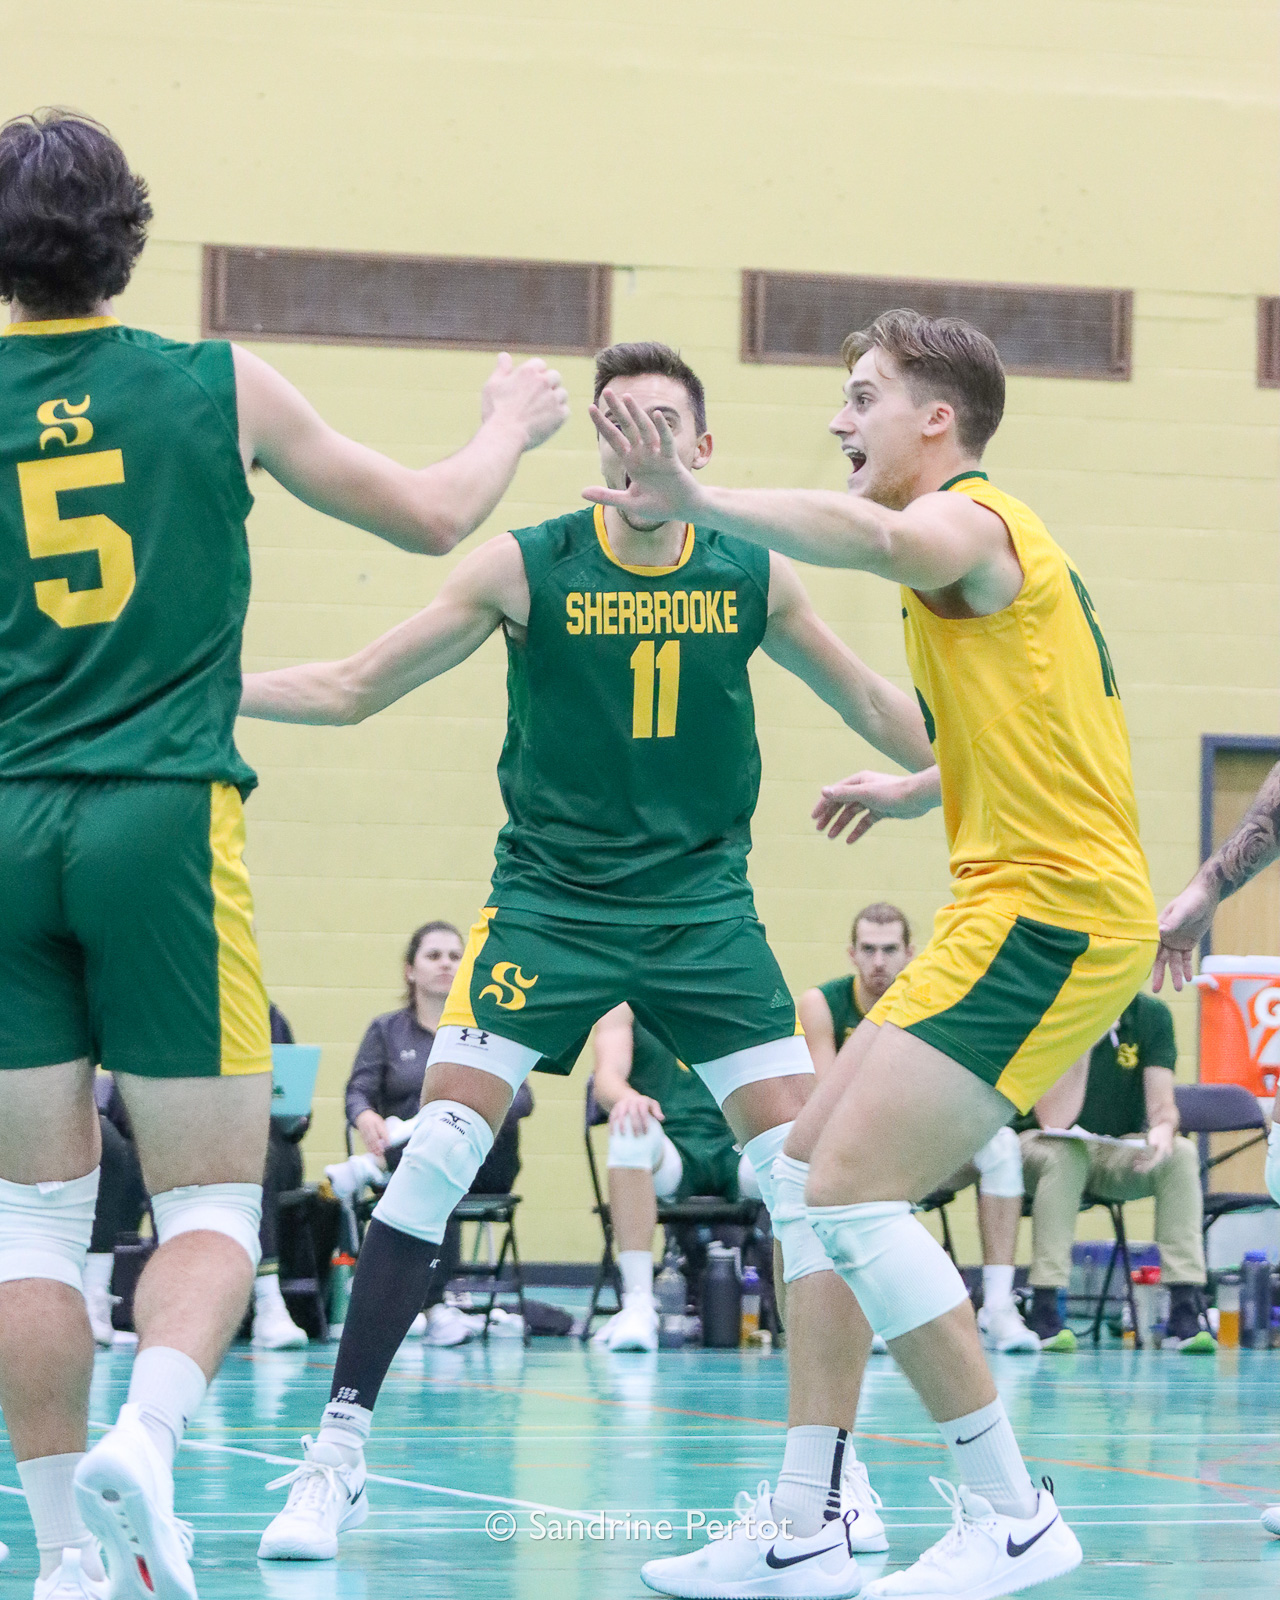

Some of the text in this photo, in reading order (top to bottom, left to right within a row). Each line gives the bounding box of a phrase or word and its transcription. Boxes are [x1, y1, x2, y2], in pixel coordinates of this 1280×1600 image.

[17, 448, 136, 628] 5
[566, 590, 738, 634] SHERBROOKE
[630, 639, 680, 738] 11
